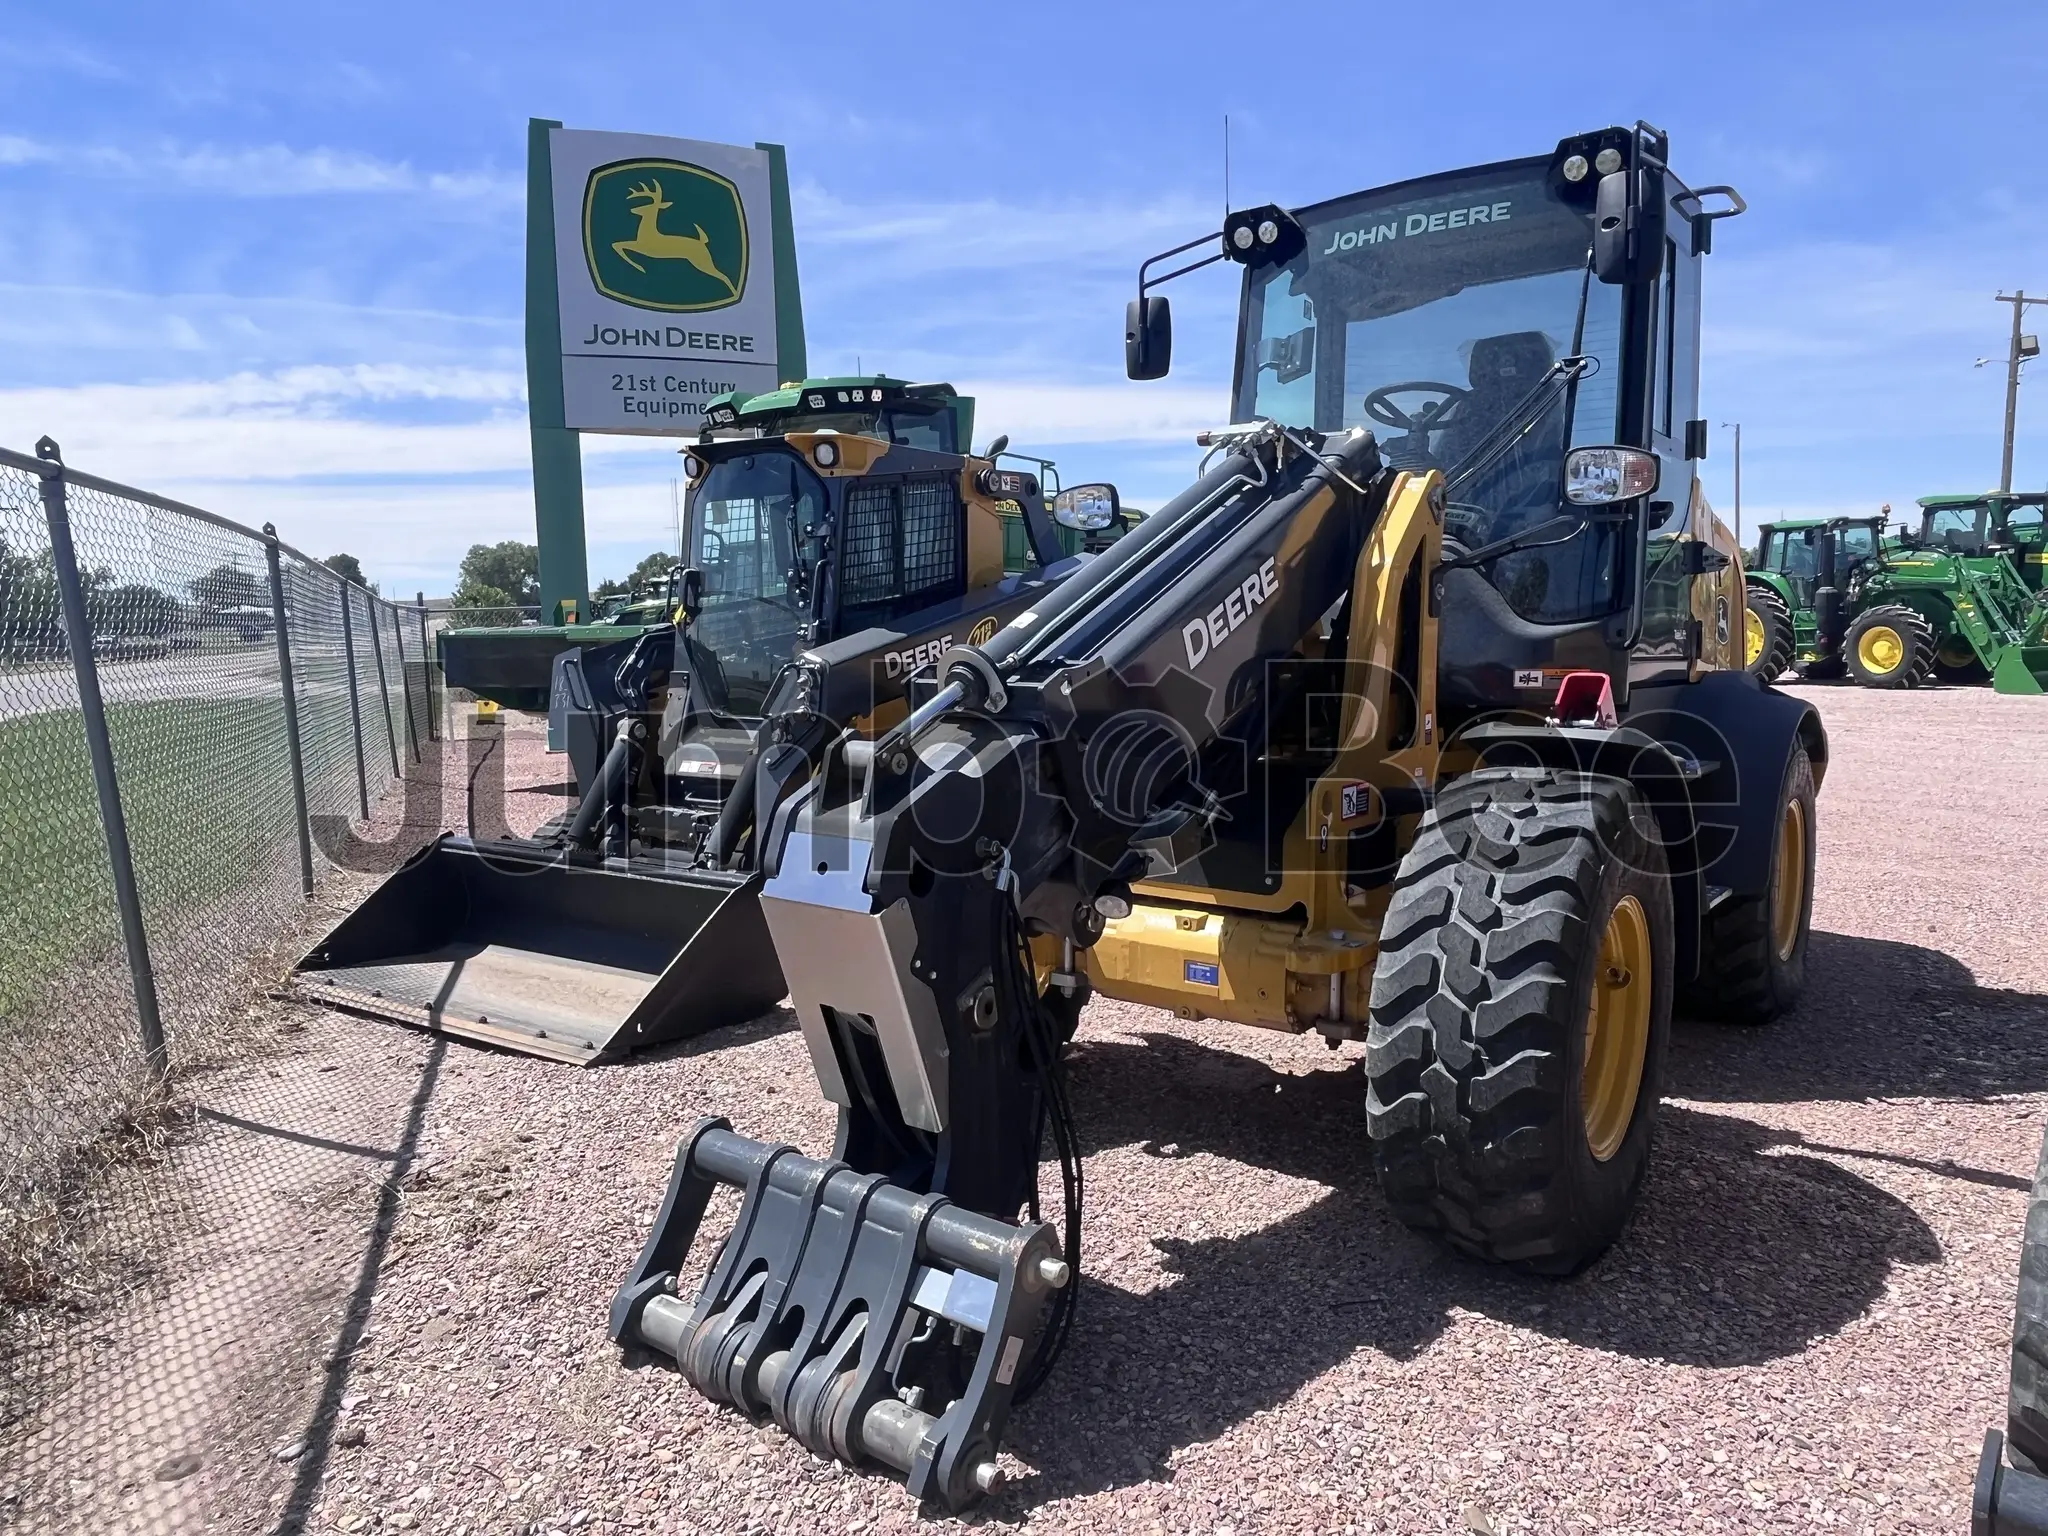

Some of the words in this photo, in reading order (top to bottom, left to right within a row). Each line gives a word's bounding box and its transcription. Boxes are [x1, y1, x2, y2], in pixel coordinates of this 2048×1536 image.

[1324, 222, 1398, 255] JOHN
[1405, 202, 1512, 237] DEERE
[583, 323, 661, 347] JOHN
[665, 326, 755, 353] DEERE
[611, 374, 657, 392] 21st
[664, 375, 736, 394] Century
[623, 396, 708, 418] Equipme
[1182, 555, 1279, 670] DEERE
